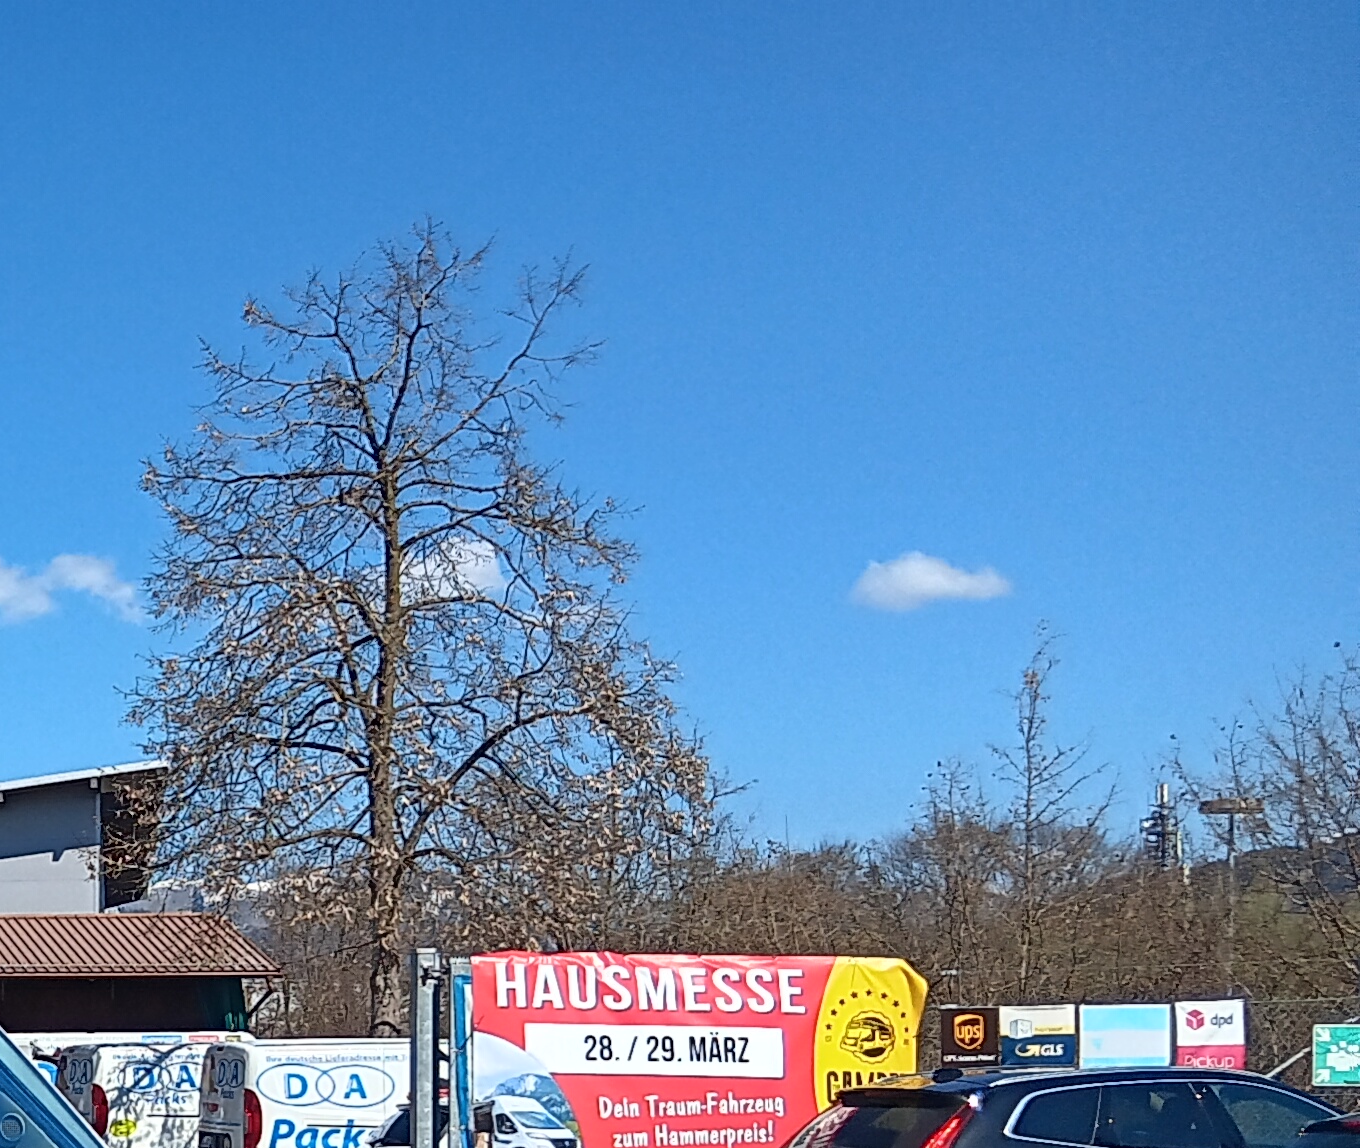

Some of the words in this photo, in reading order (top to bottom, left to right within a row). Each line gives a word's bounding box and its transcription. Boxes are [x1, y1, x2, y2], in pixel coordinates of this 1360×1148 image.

[495, 962, 806, 1014] HAUSMESSE
[1211, 1013, 1233, 1028] dpd
[956, 1024, 980, 1043] ups
[584, 1035, 620, 1061] 28.
[646, 1035, 682, 1062] 29.
[689, 1032, 749, 1063] MÄRZ
[1041, 1043, 1065, 1056] GLS
[1184, 1055, 1235, 1069] Pickup
[284, 1073, 308, 1099] D
[344, 1073, 367, 1099] A
[598, 1096, 641, 1119] Dein
[644, 1091, 785, 1119] Traum-Fahrzeug
[613, 1131, 649, 1148] zum
